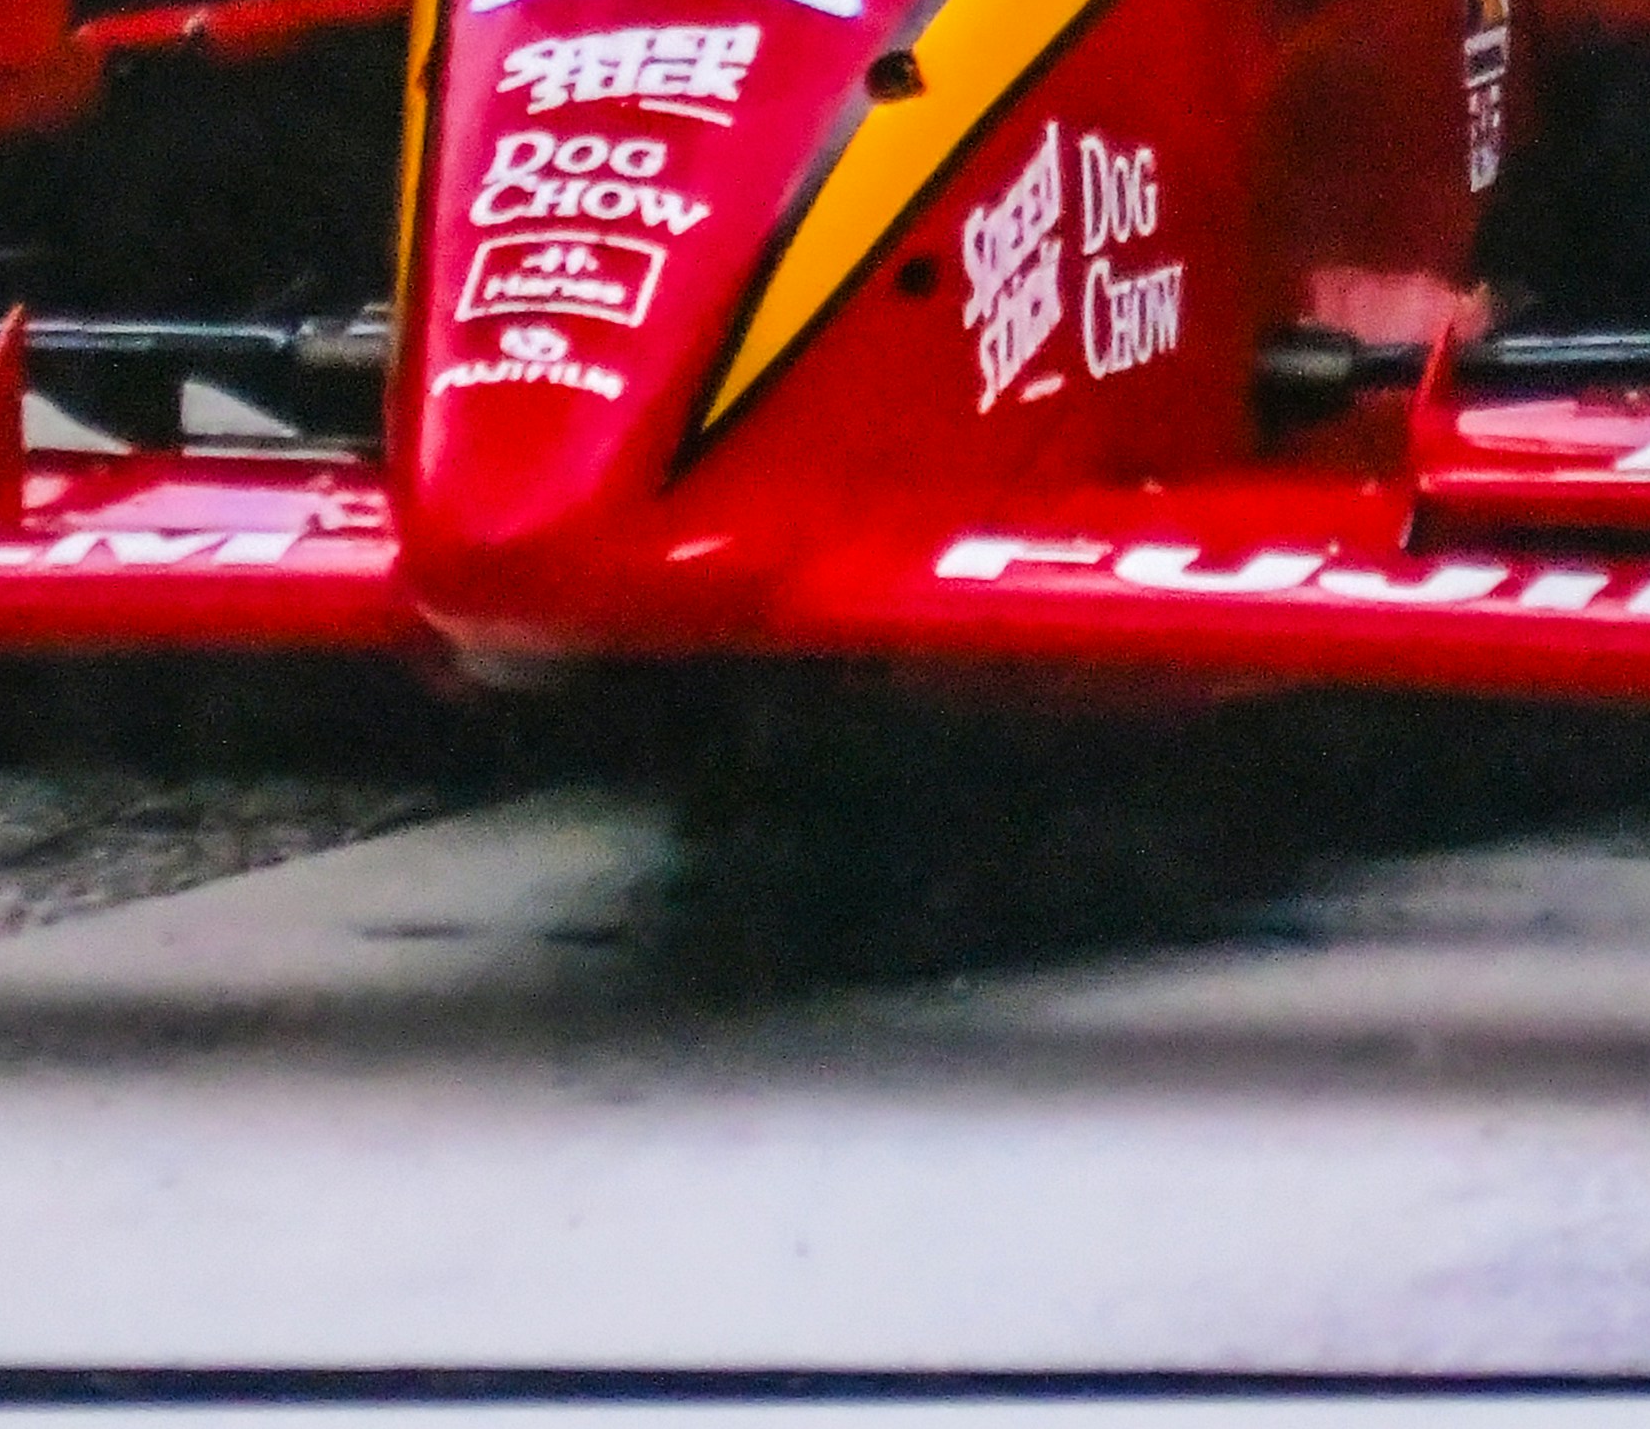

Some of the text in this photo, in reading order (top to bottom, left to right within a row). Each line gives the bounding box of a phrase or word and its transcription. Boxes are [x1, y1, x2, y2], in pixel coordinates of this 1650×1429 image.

[481, 131, 669, 186] DOG
[1079, 133, 1158, 257] DOG
[469, 180, 712, 236] CHOW
[1083, 258, 1184, 381] CHOW
